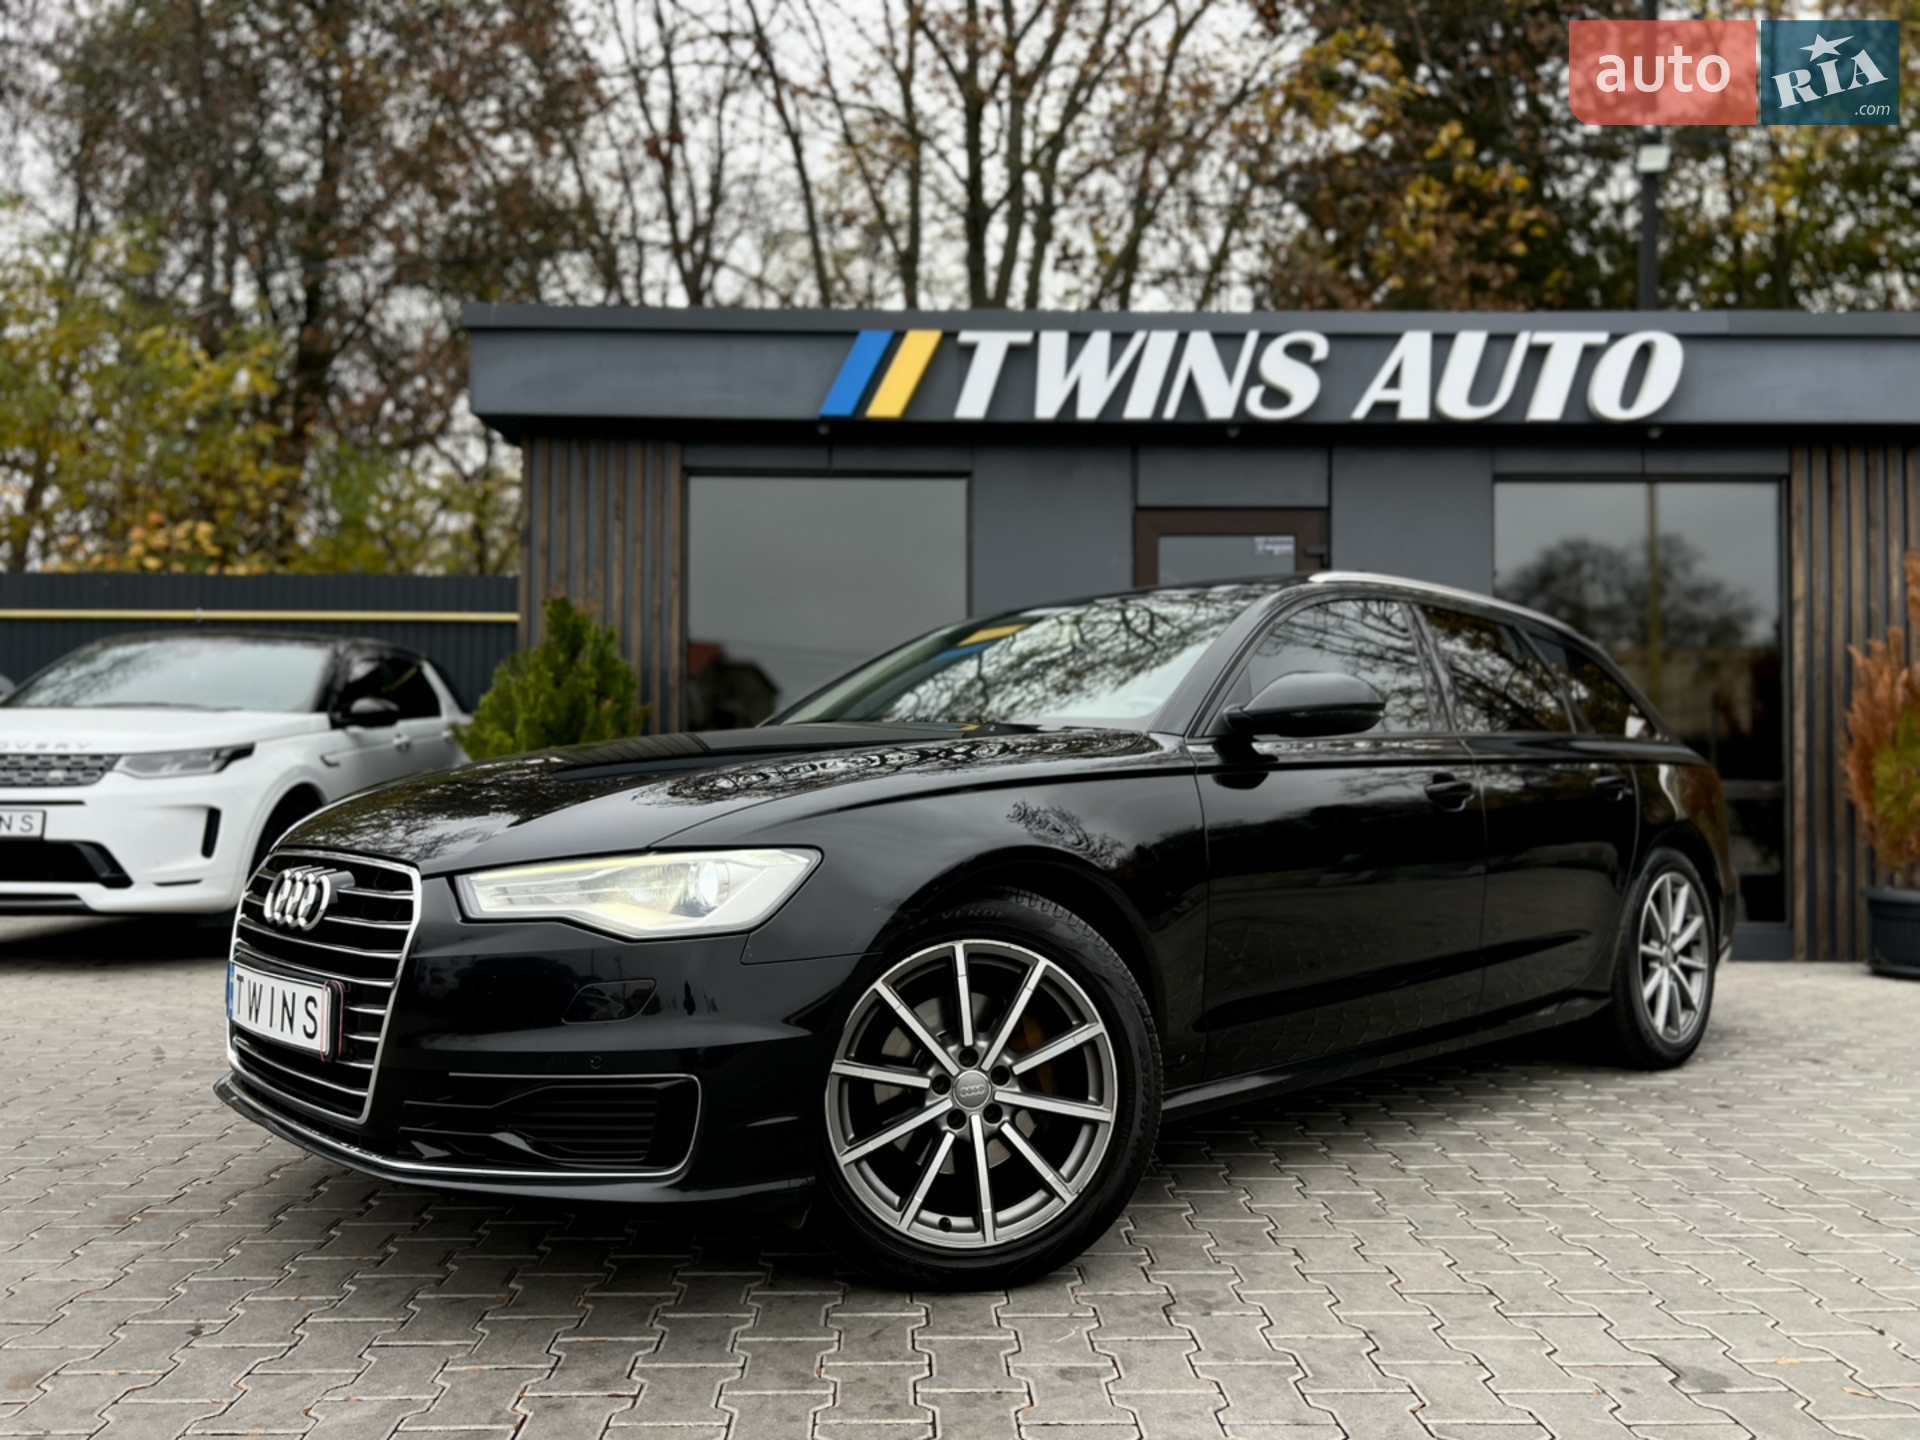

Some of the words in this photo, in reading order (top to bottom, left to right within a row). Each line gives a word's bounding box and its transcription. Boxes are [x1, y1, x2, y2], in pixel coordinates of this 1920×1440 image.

[953, 329, 1330, 421] TWINS
[1350, 330, 1684, 422] AUTO
[941, 909, 1004, 919] VERDE
[236, 974, 318, 1040] TWINS
